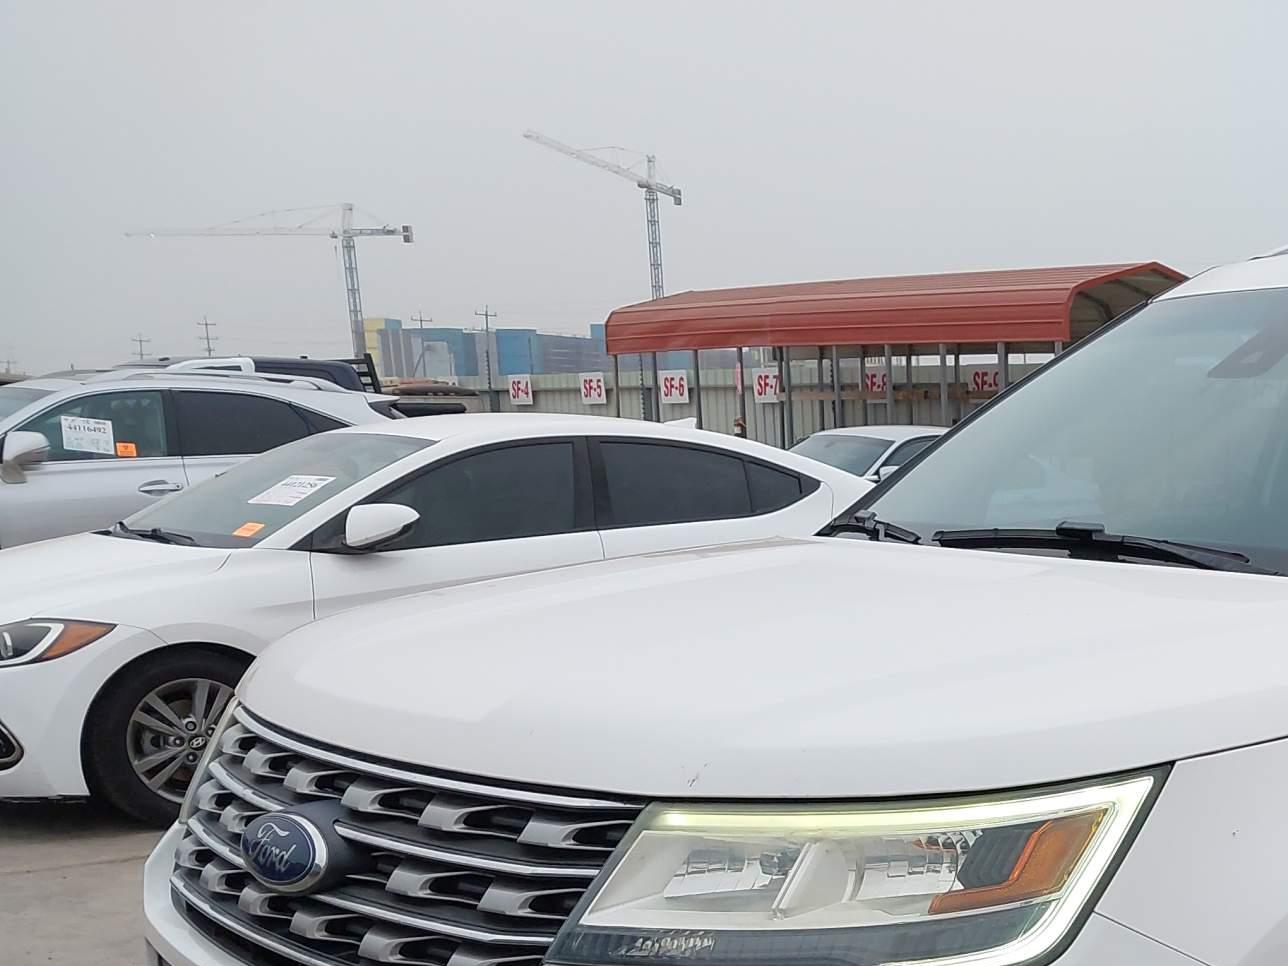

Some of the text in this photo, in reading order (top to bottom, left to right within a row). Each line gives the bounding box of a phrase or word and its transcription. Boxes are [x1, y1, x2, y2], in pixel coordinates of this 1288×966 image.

[511, 380, 529, 399] SF-4
[583, 379, 602, 398] SF-5
[663, 376, 685, 397] SF-6
[757, 374, 780, 396] SF-7
[249, 822, 297, 872] Ford
